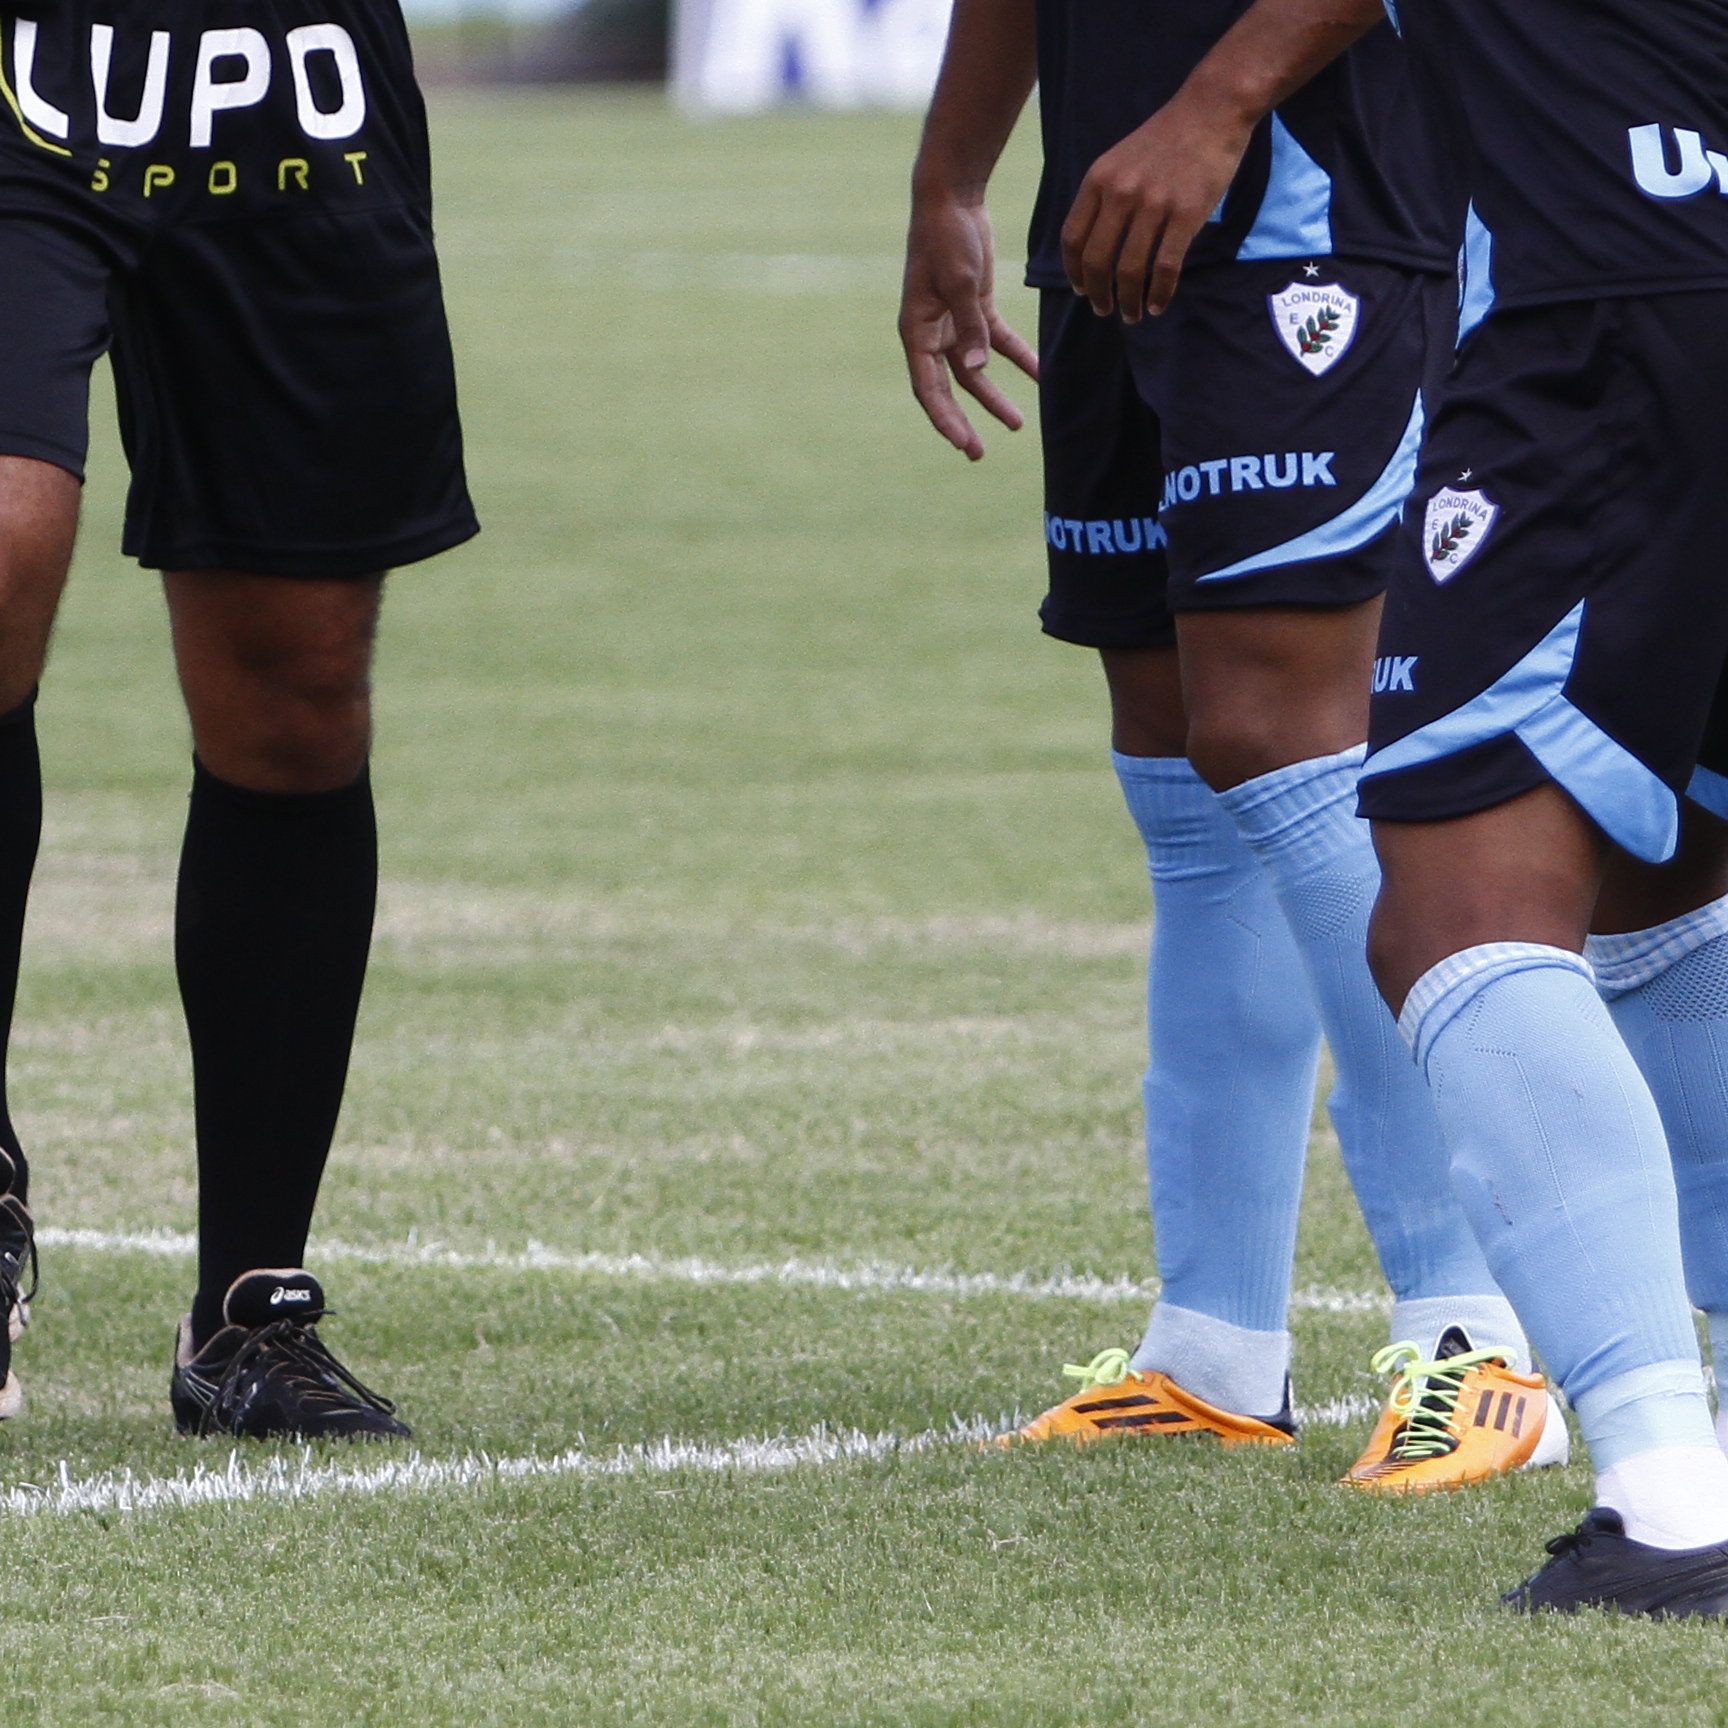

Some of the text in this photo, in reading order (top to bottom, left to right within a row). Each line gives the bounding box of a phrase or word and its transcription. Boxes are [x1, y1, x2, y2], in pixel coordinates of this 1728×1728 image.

[12, 16, 367, 148] LUPO
[90, 150, 368, 198] SPORT
[1281, 290, 1353, 314] LONDRINA
[1289, 312, 1300, 325] E
[1324, 345, 1335, 358] C
[1157, 450, 1338, 513] NOTRUK
[1432, 496, 1489, 522] LONDRINA
[1431, 518, 1440, 531] E
[1449, 552, 1459, 565] C
